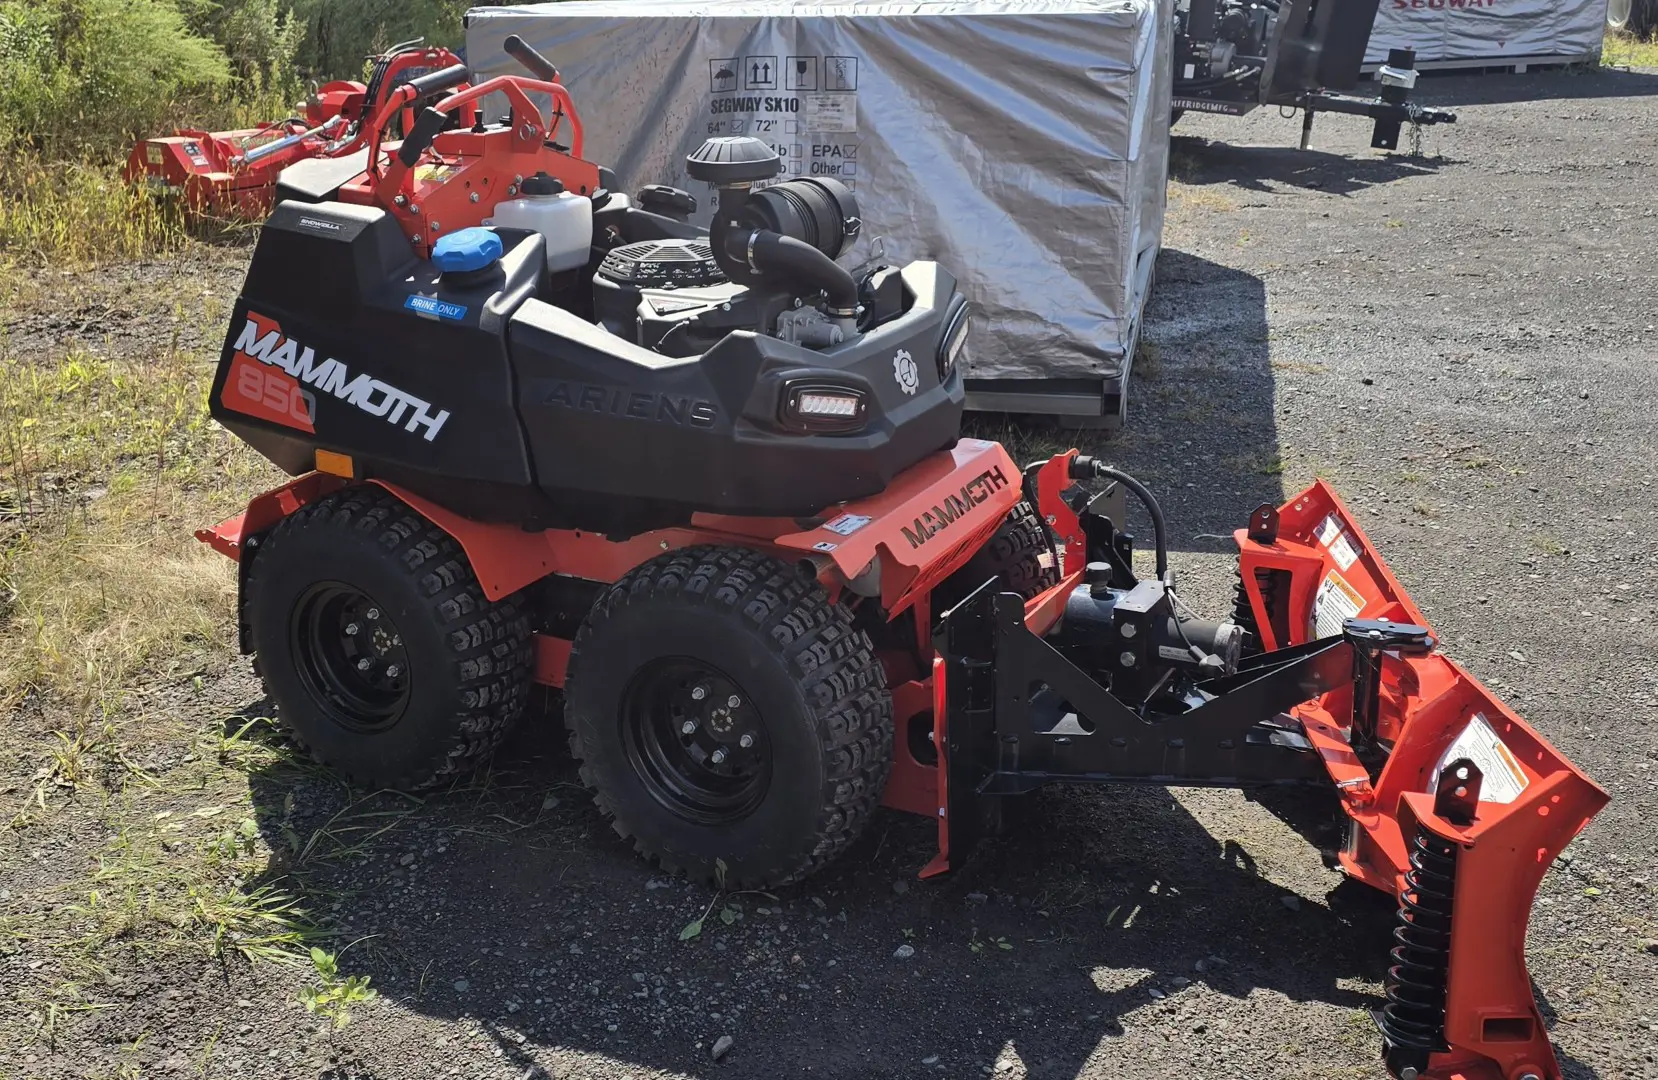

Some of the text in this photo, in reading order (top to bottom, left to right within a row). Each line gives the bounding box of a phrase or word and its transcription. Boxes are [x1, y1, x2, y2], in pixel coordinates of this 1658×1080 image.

[711, 97, 799, 114] SEGWAY SX10
[707, 121, 726, 134] 64"
[755, 119, 778, 132] 72"
[812, 144, 842, 157] EPA
[811, 161, 842, 175] Other
[752, 180, 767, 189] lue
[410, 298, 461, 317] BRINE ONLY
[233, 319, 451, 442] MAMMOTH
[237, 363, 317, 425] 850
[542, 382, 720, 430] ARIENS
[900, 464, 1009, 549] MAMMOTH
